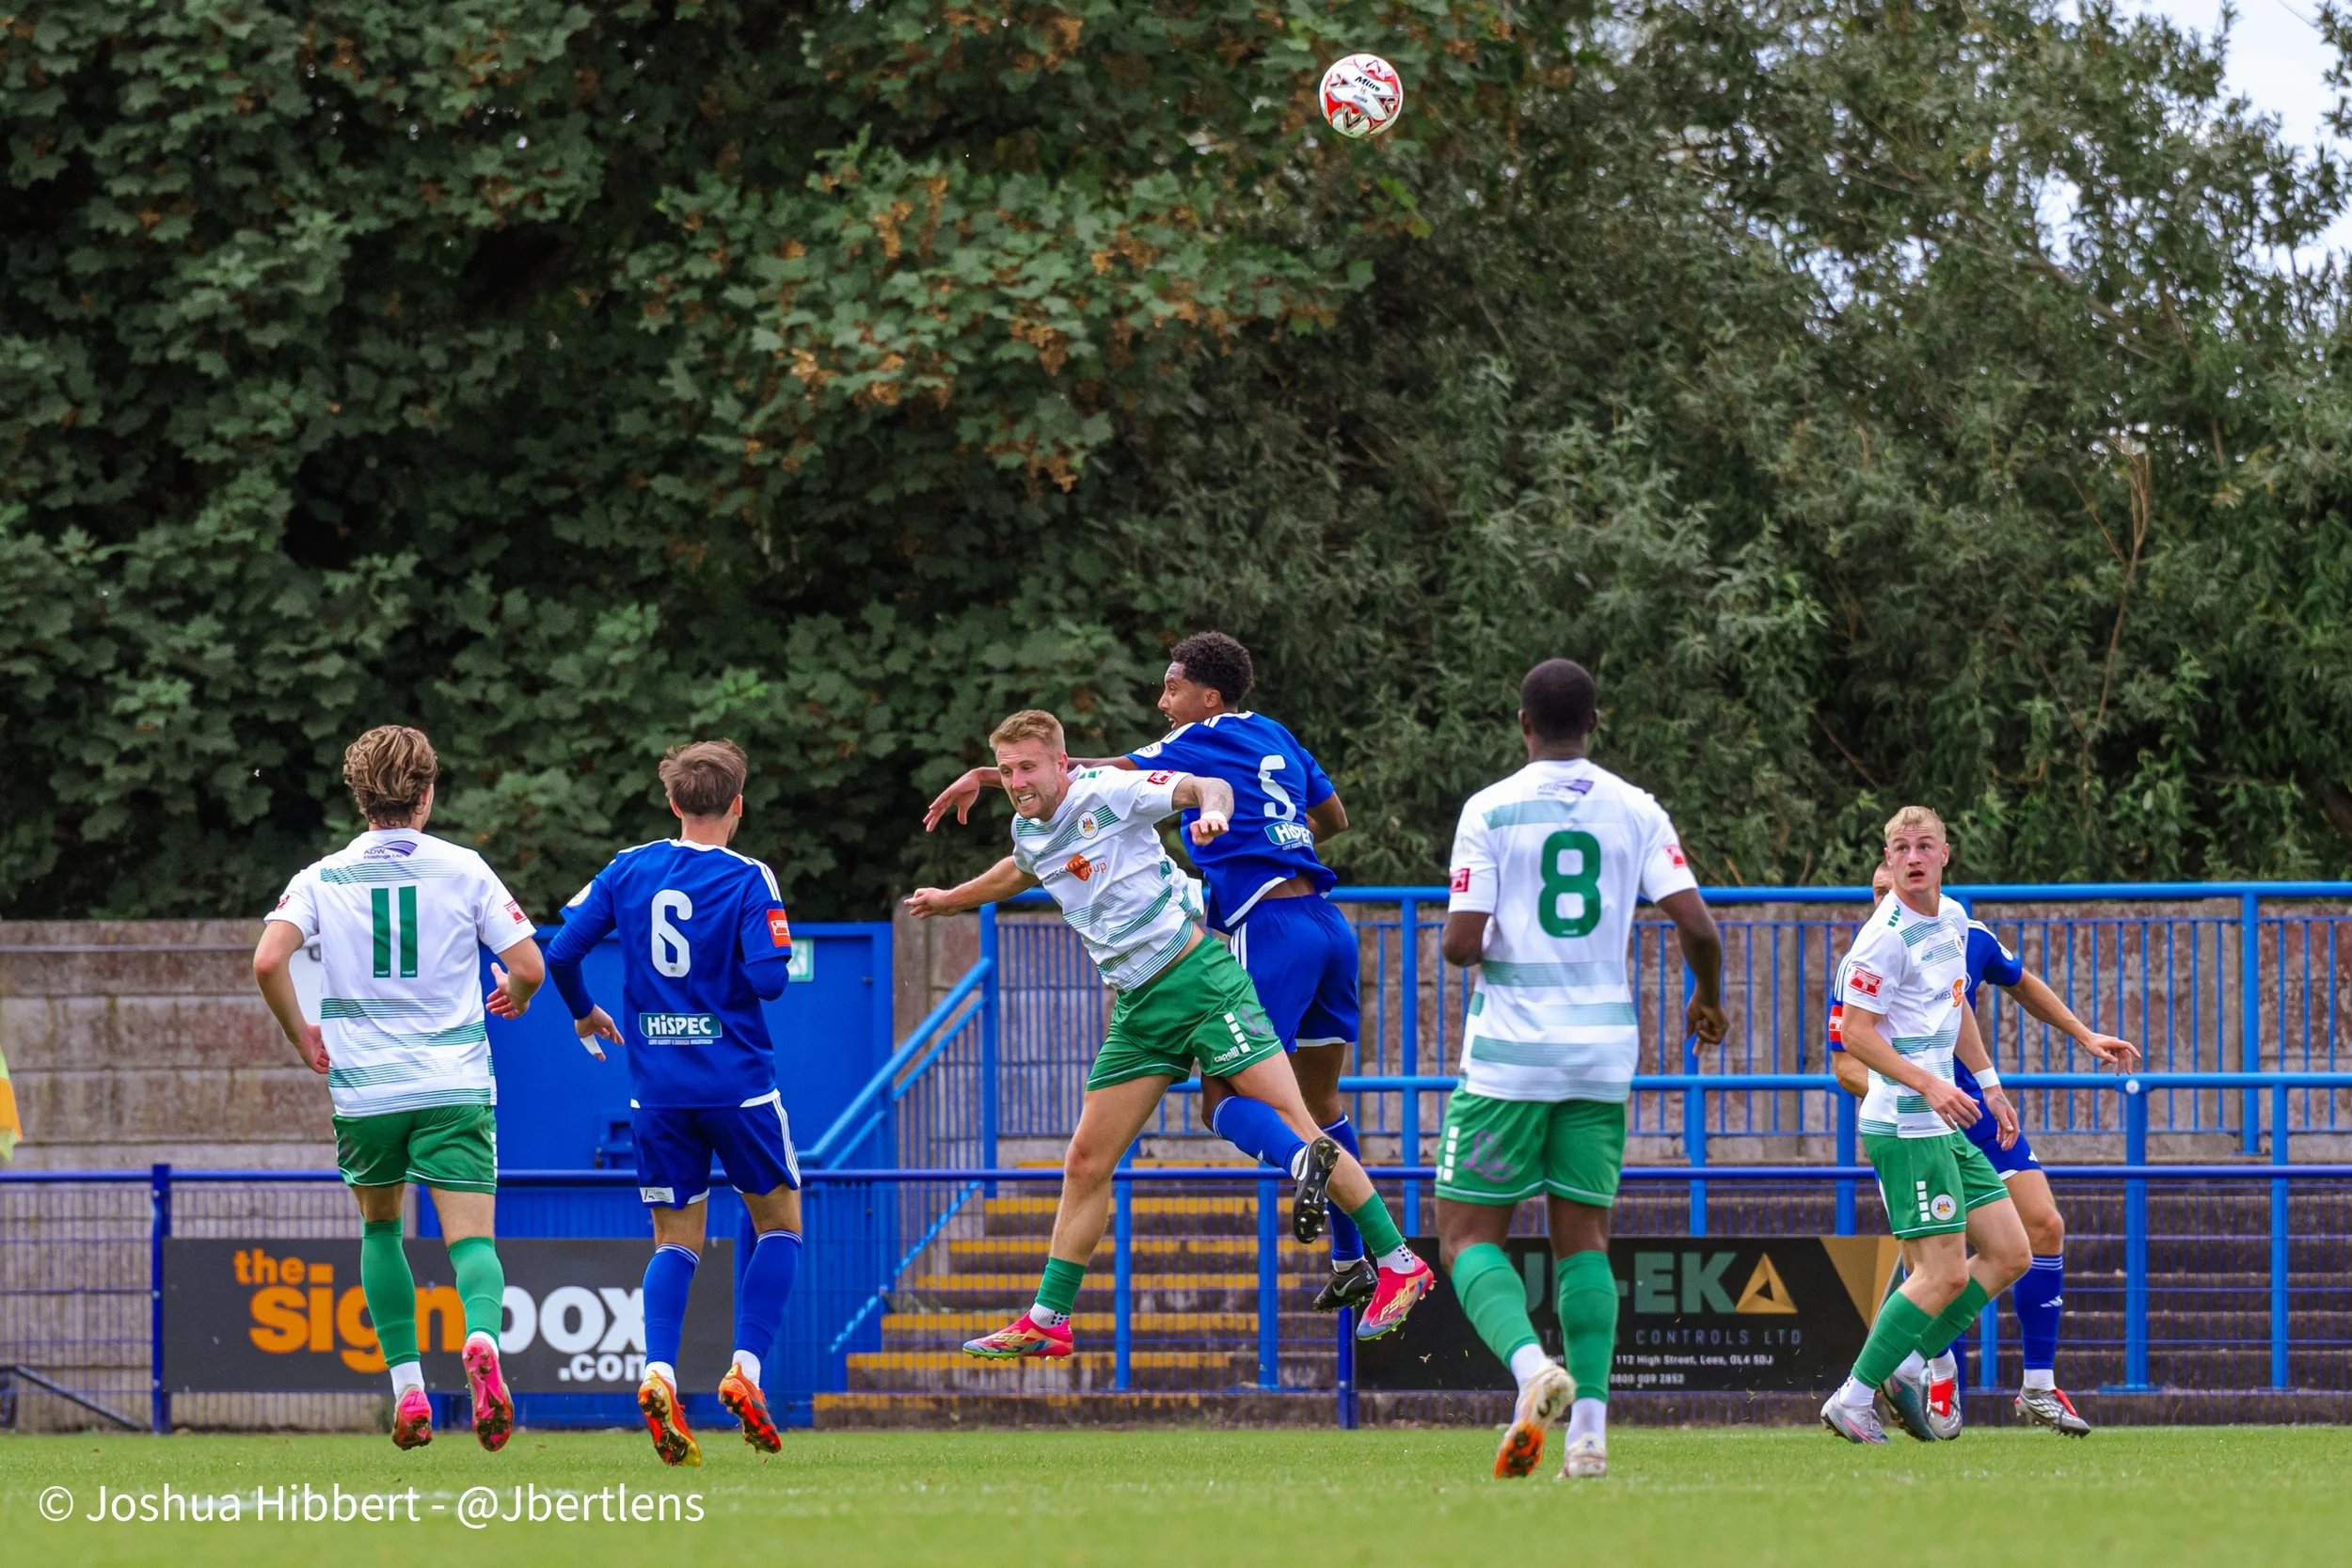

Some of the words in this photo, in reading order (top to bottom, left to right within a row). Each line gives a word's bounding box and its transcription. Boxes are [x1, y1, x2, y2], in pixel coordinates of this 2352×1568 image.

[1258, 754, 1296, 821] 5
[1538, 830, 1600, 938] 8
[371, 885, 418, 978] 11
[651, 889, 693, 977] 6
[233, 1248, 306, 1285] the
[1635, 1329, 1749, 1345] CONTROLS
[1764, 1329, 1802, 1345] LTD
[1637, 1354, 1661, 1367] High
